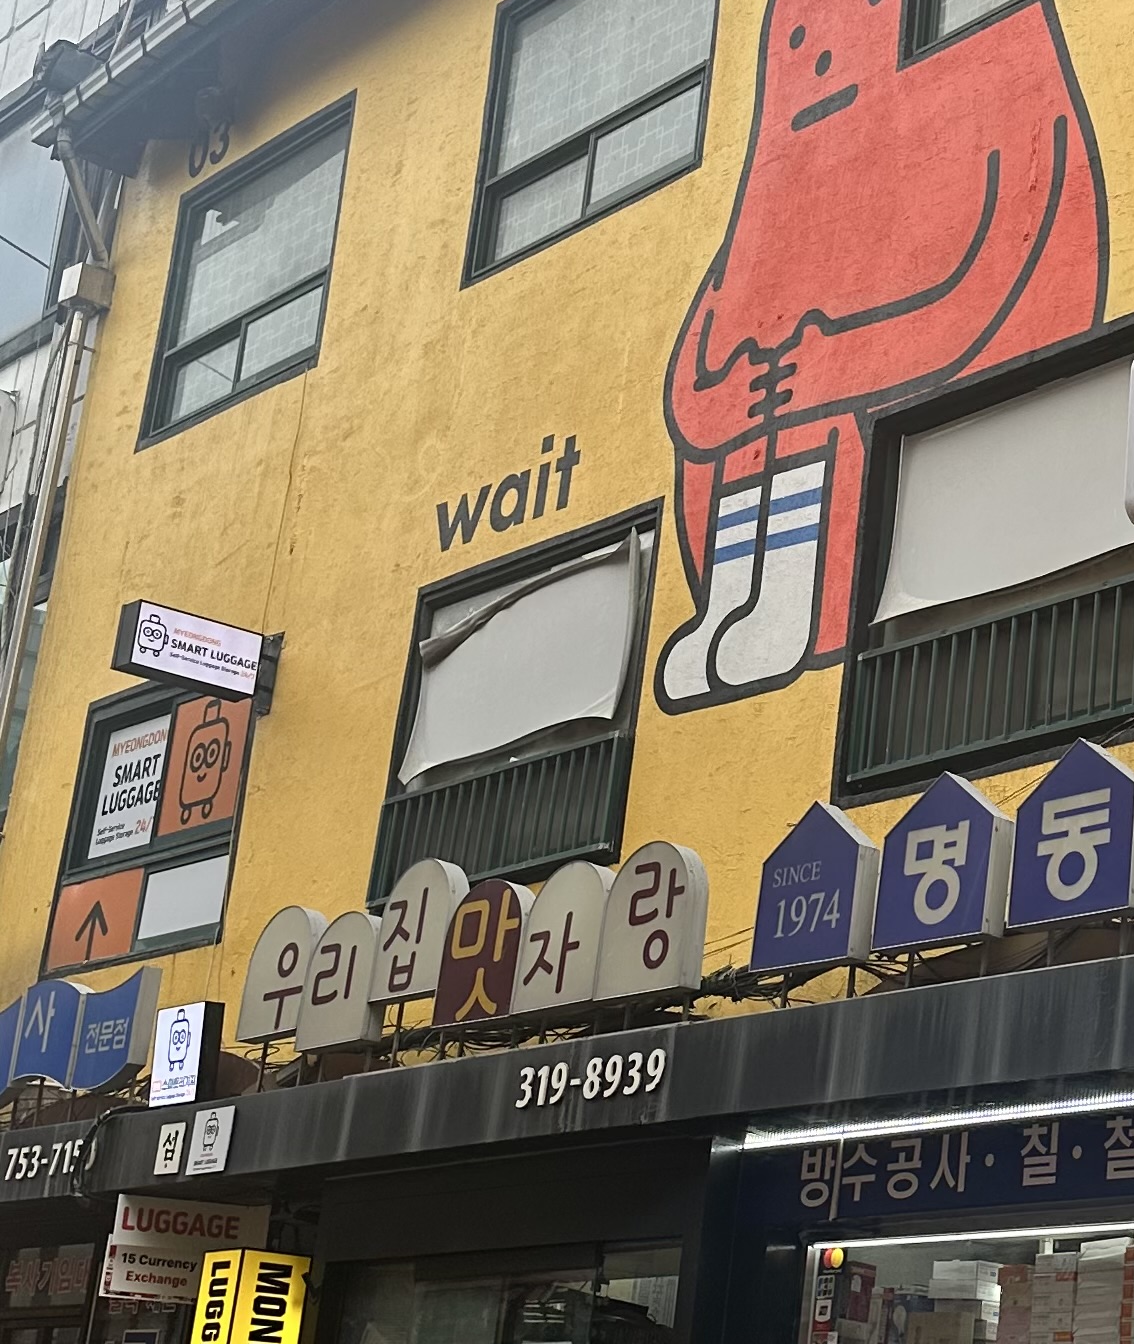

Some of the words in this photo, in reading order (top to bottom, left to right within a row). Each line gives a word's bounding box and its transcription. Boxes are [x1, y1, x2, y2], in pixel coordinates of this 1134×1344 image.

[436, 434, 581, 553] wait
[171, 638, 208, 657] SMART
[210, 650, 258, 671] LUGGAGE
[112, 754, 161, 787] SMART
[101, 780, 160, 816] LUGGAGE
[771, 859, 822, 889] SINCE
[773, 891, 841, 939] 1974
[84, 1017, 130, 1054] 전문점
[515, 1048, 667, 1109] 319-8939
[4, 1137, 97, 1181] 753-715
[121, 1206, 240, 1240] LUGGAGE
[121, 1252, 136, 1264] 15
[138, 1254, 198, 1272] Currency
[125, 1270, 187, 1288] Exchange
